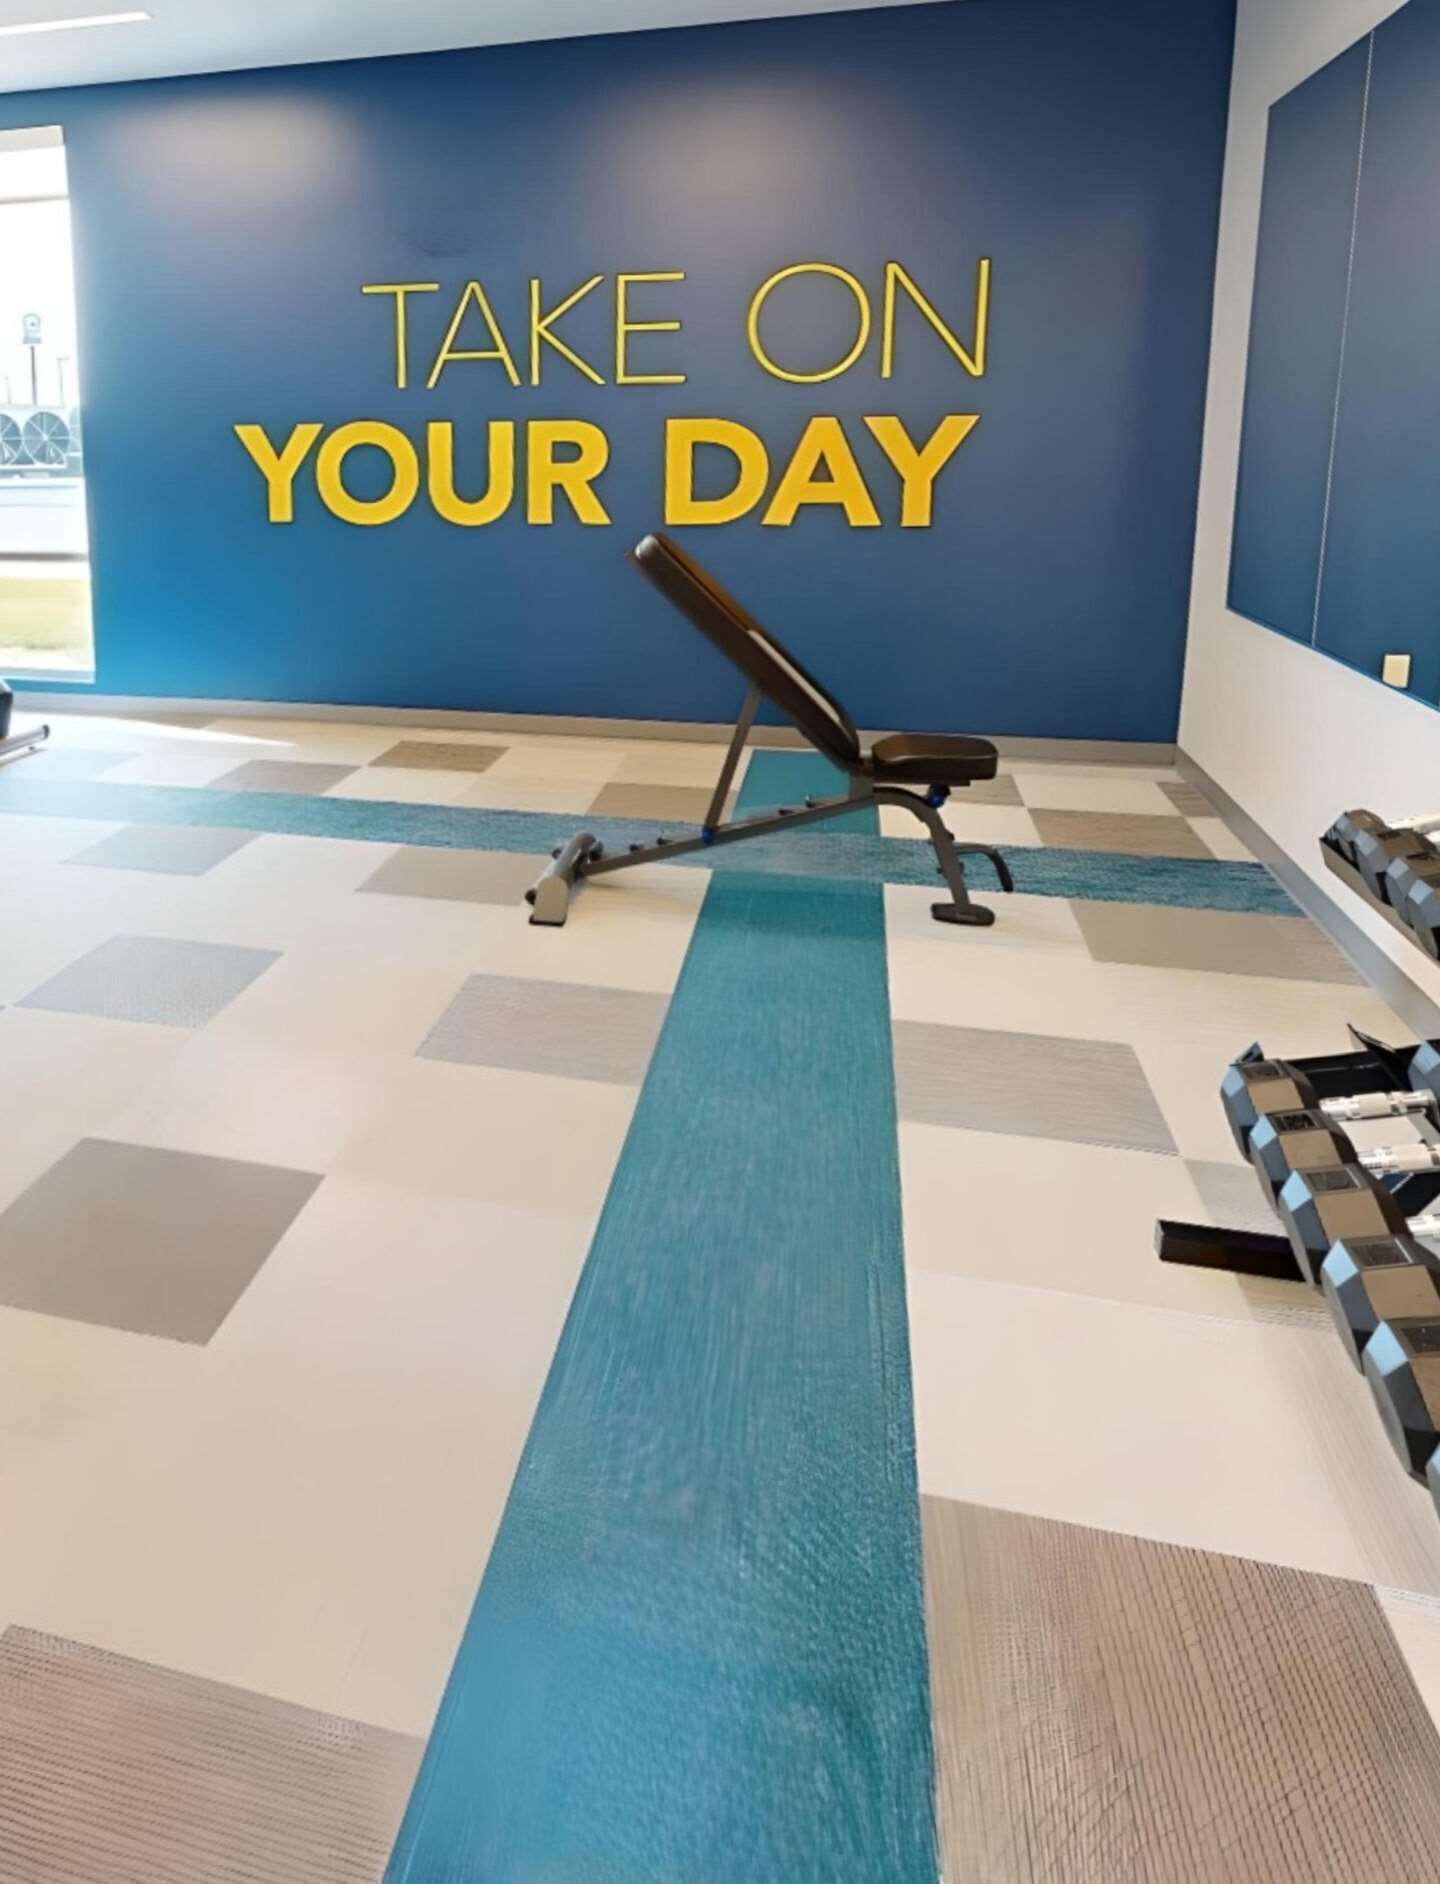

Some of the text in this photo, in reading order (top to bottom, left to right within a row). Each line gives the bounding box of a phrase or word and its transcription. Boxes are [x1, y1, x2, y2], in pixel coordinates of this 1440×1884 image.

[361, 256, 993, 390] TAKE ON
[233, 413, 981, 528] YOUR DAY
